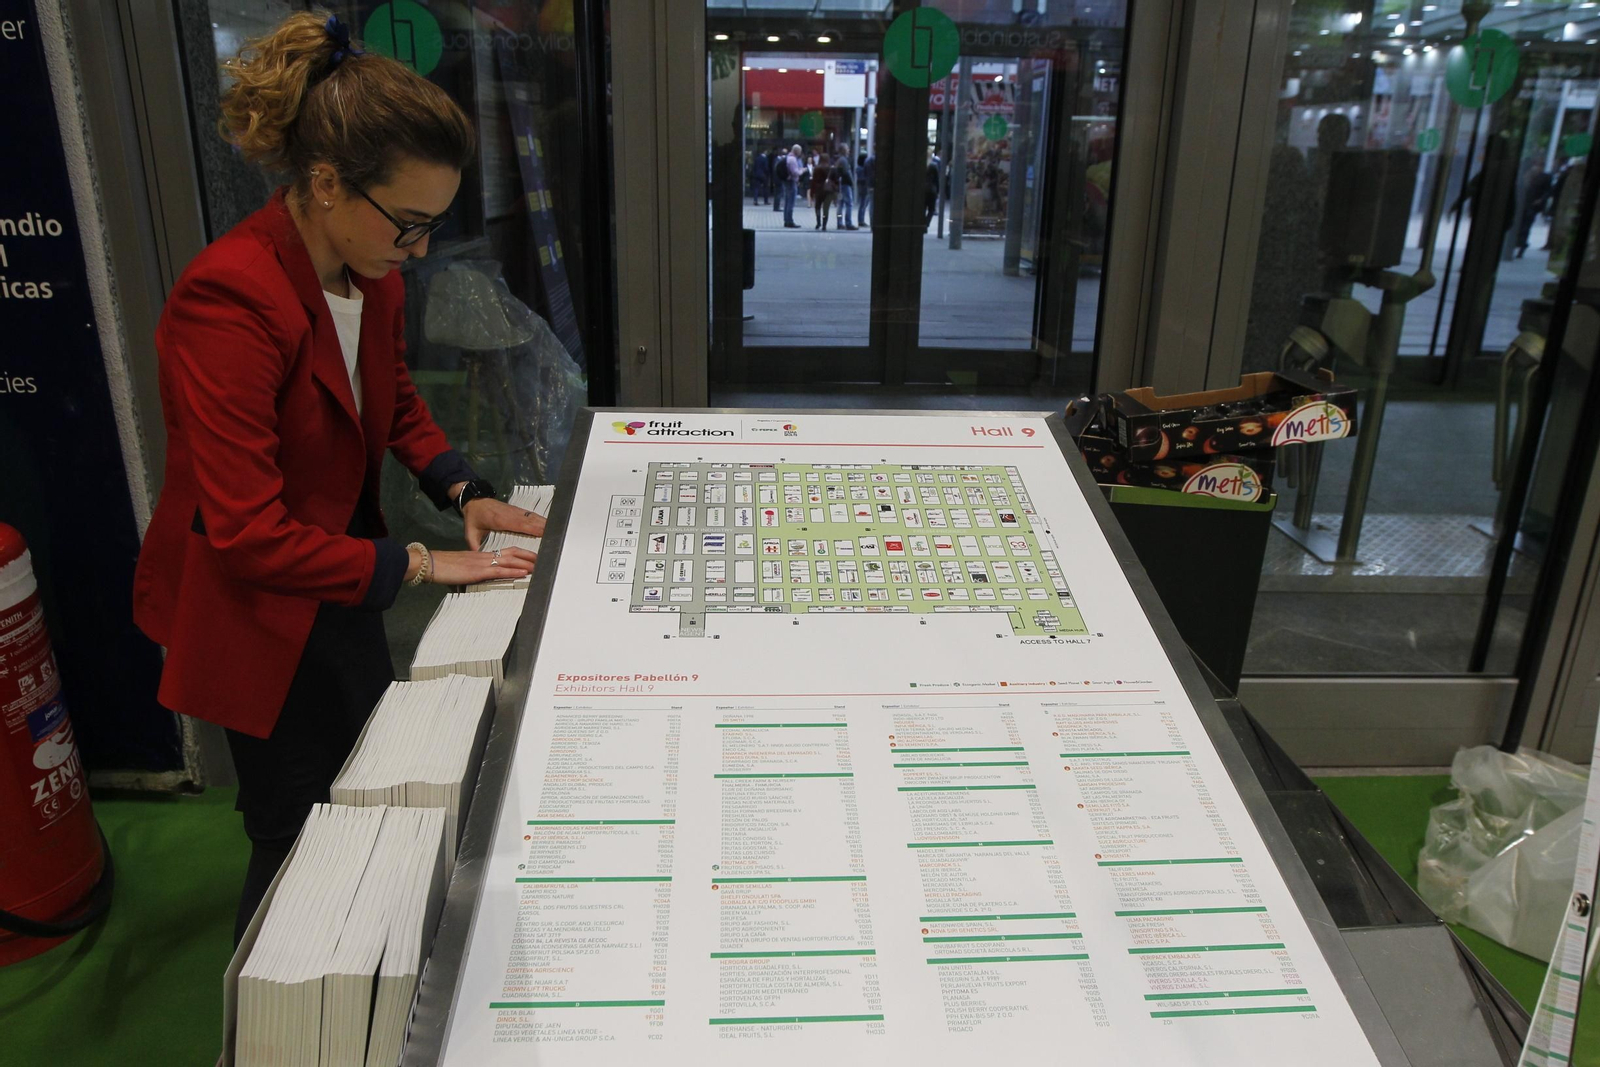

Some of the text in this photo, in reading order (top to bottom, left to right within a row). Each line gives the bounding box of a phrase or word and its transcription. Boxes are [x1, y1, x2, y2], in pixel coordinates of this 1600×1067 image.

[1, 20, 26, 41] er
[648, 420, 683, 428] fruit
[647, 428, 735, 437] attraction
[971, 426, 1036, 438] Hall 9
[557, 673, 699, 684] Expositores Pabellón 9
[555, 684, 655, 693] Exhibitors Hall 9
